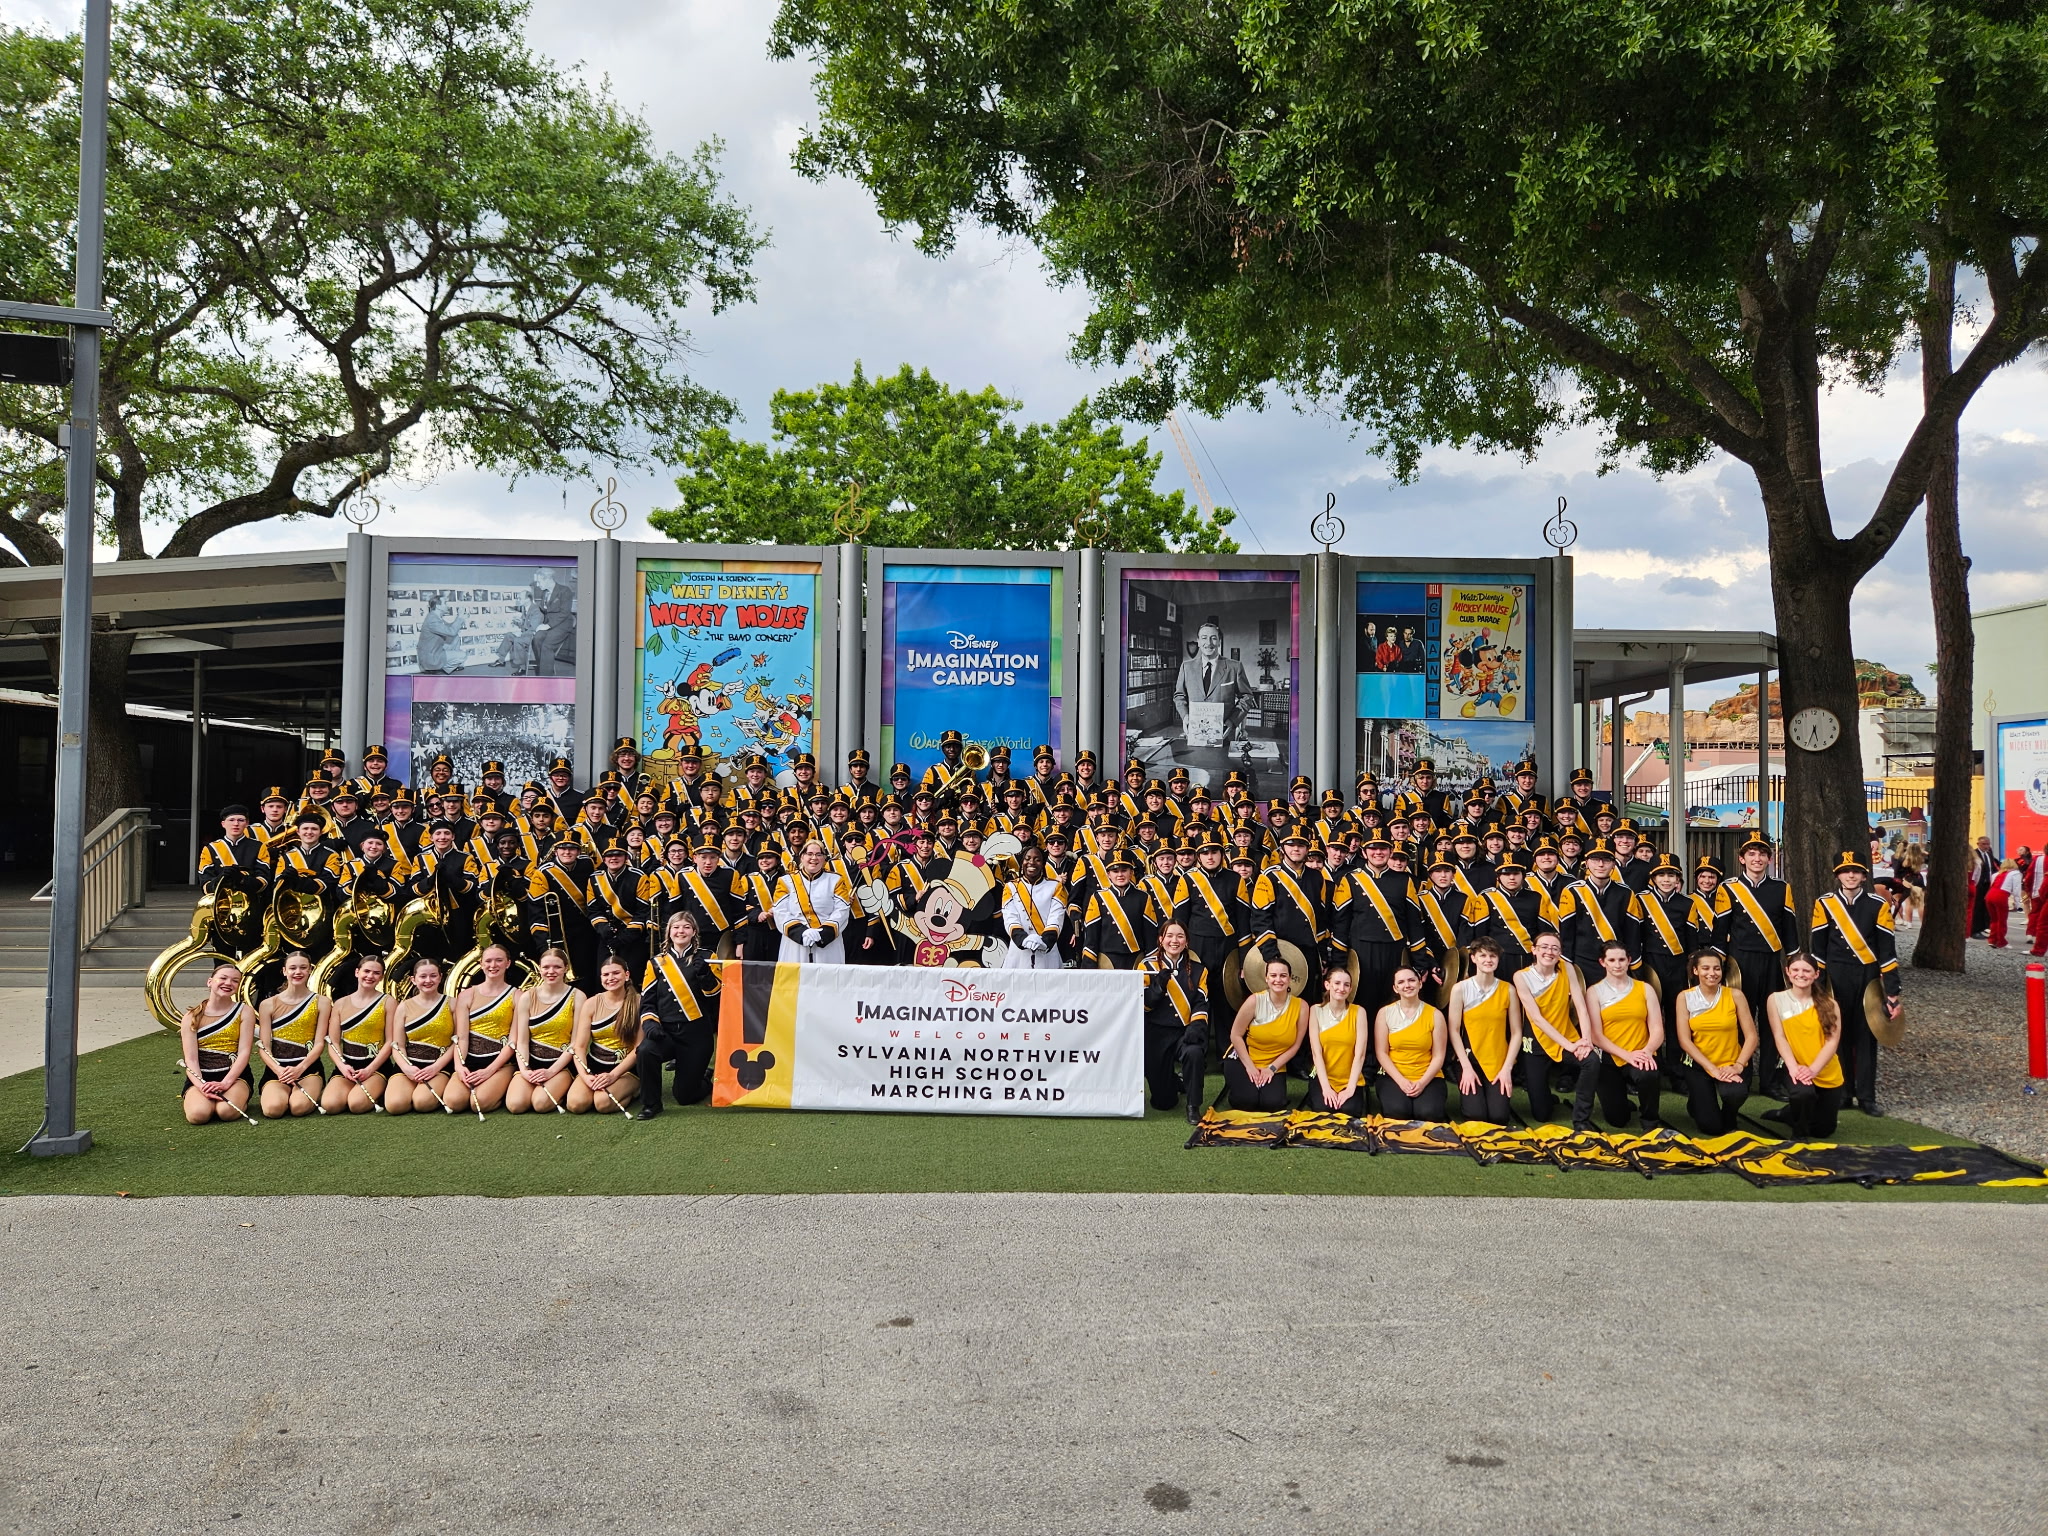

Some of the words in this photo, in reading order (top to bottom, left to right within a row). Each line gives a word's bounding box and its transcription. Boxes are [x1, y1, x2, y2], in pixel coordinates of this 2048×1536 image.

[671, 585, 713, 599] WALT
[719, 581, 789, 600] DISNEY'S
[1460, 592, 1478, 601] Walt
[649, 602, 728, 628] MICKEY
[736, 604, 809, 629] MOUSE
[1452, 602, 1482, 612] MICKEY
[1483, 603, 1510, 616] MOUSE
[1459, 615, 1475, 623] CLUB
[1477, 616, 1501, 625] PARADE
[728, 633, 752, 642] BAND
[932, 670, 1016, 686] CAMPUS
[994, 736, 1032, 750] World
[2010, 740, 2032, 751] MICKEY
[1002, 1008, 1089, 1024] CAMPUS
[889, 1030, 1053, 1042] WELCOMES
[838, 1044, 952, 1061] SYLVANIA
[964, 1047, 1102, 1064] NORTHVIEW
[890, 1065, 945, 1080] HIGH
[956, 1066, 1048, 1082] SCHOOL
[871, 1084, 993, 1100] MARCHING
[1004, 1086, 1066, 1102] BAND
